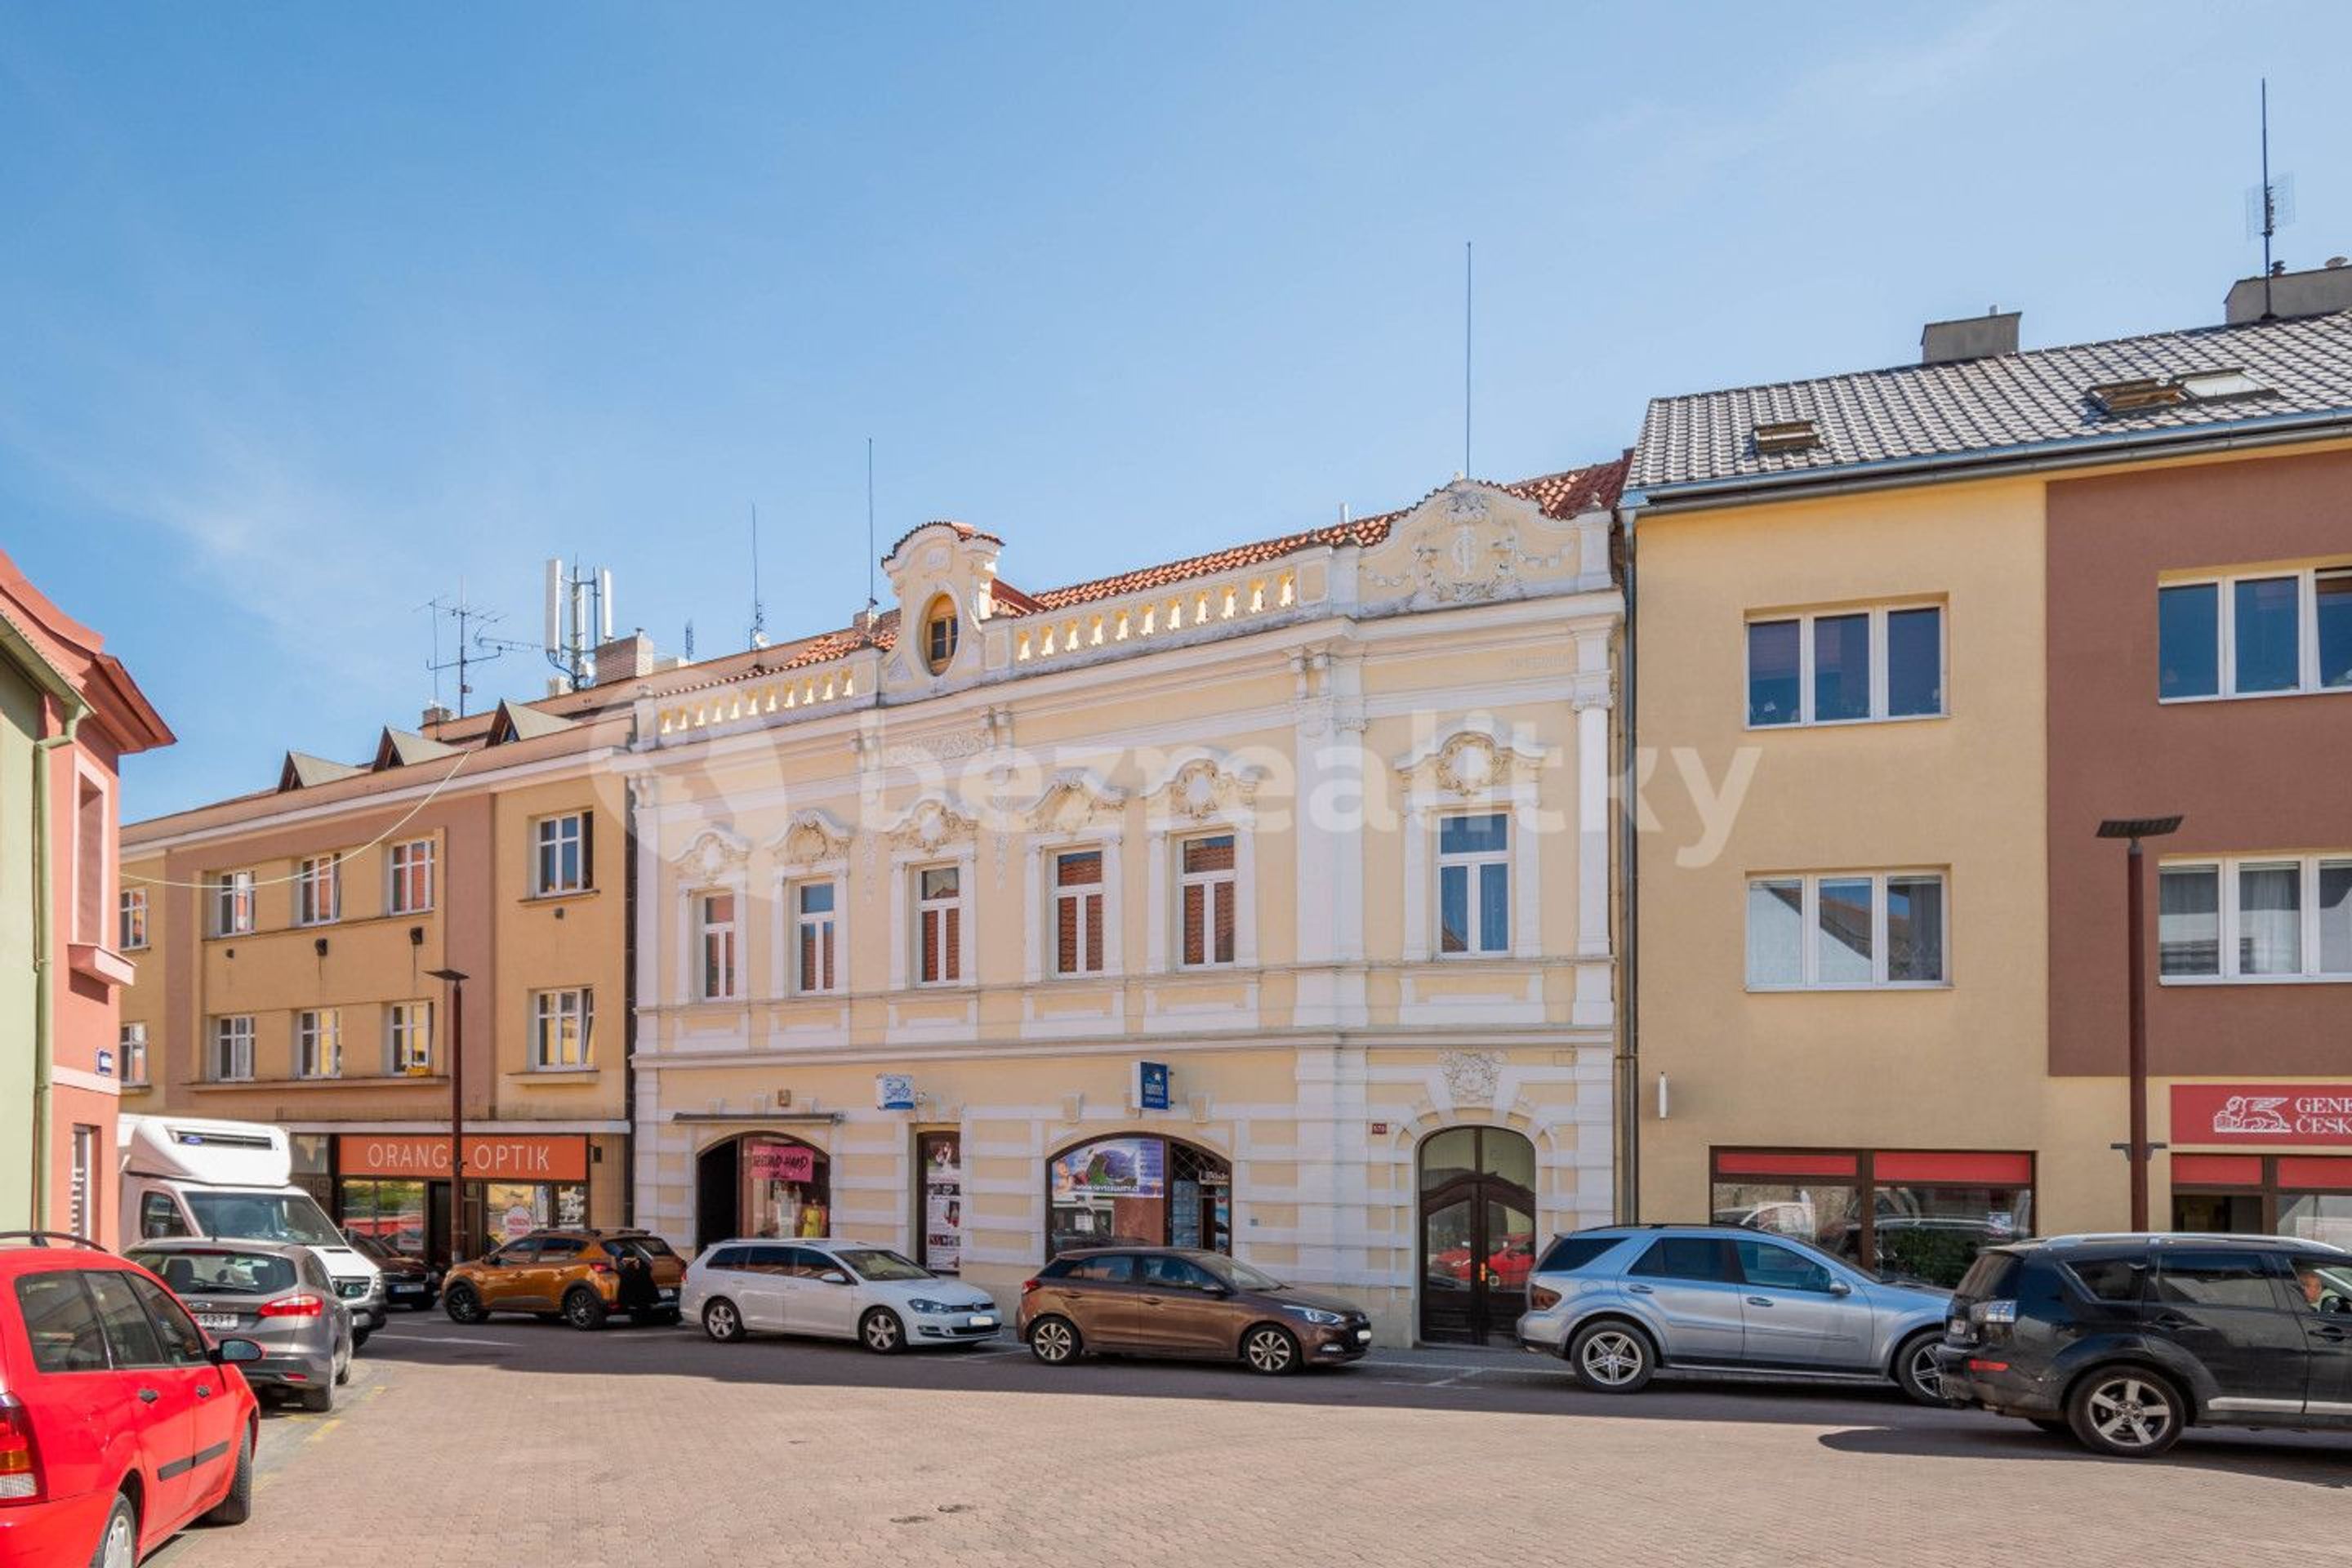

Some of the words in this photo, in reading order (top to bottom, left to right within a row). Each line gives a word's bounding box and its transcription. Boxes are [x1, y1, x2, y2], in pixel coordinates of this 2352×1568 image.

[2296, 1113, 2352, 1134] ČESK
[368, 1143, 459, 1169] ORANG
[474, 1144, 550, 1170] OPTIK
